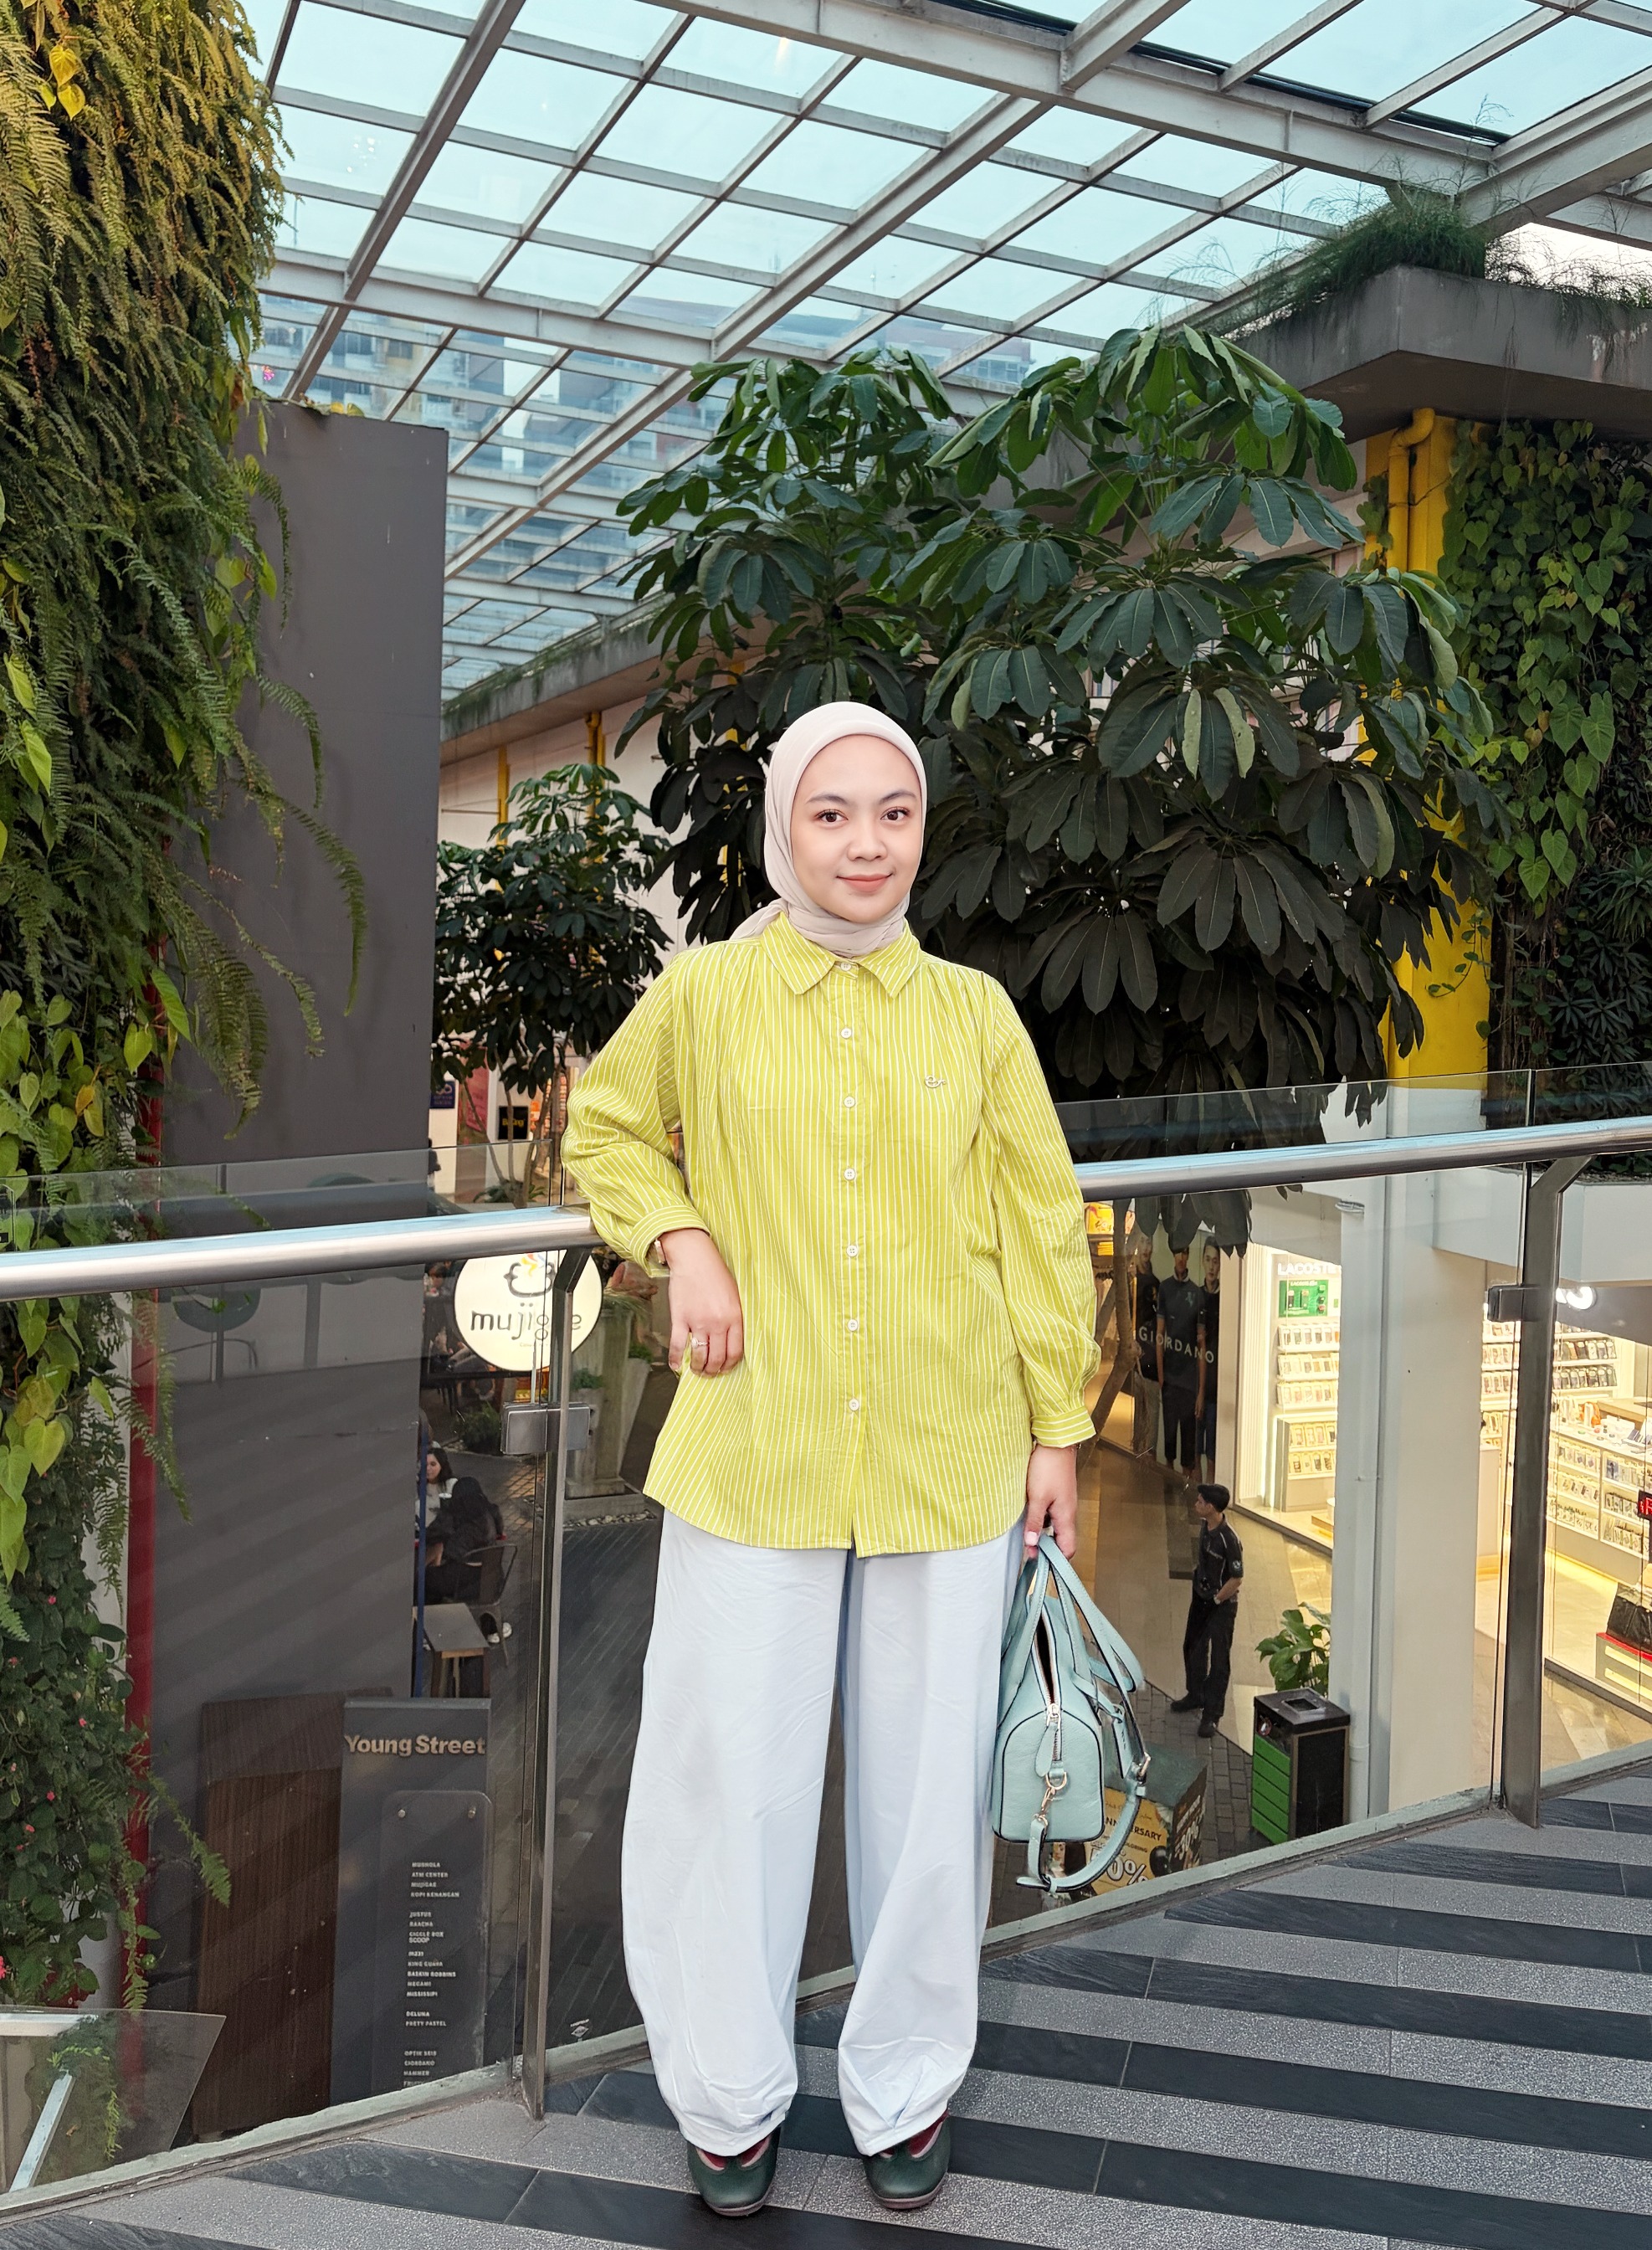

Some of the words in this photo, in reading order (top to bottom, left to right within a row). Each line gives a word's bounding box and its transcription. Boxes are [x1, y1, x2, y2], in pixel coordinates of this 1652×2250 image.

[470, 1302, 582, 1340] mujige
[1138, 1325, 1214, 1364] GIORDANO
[344, 1734, 412, 1757] Young
[415, 1734, 486, 1755] Street
